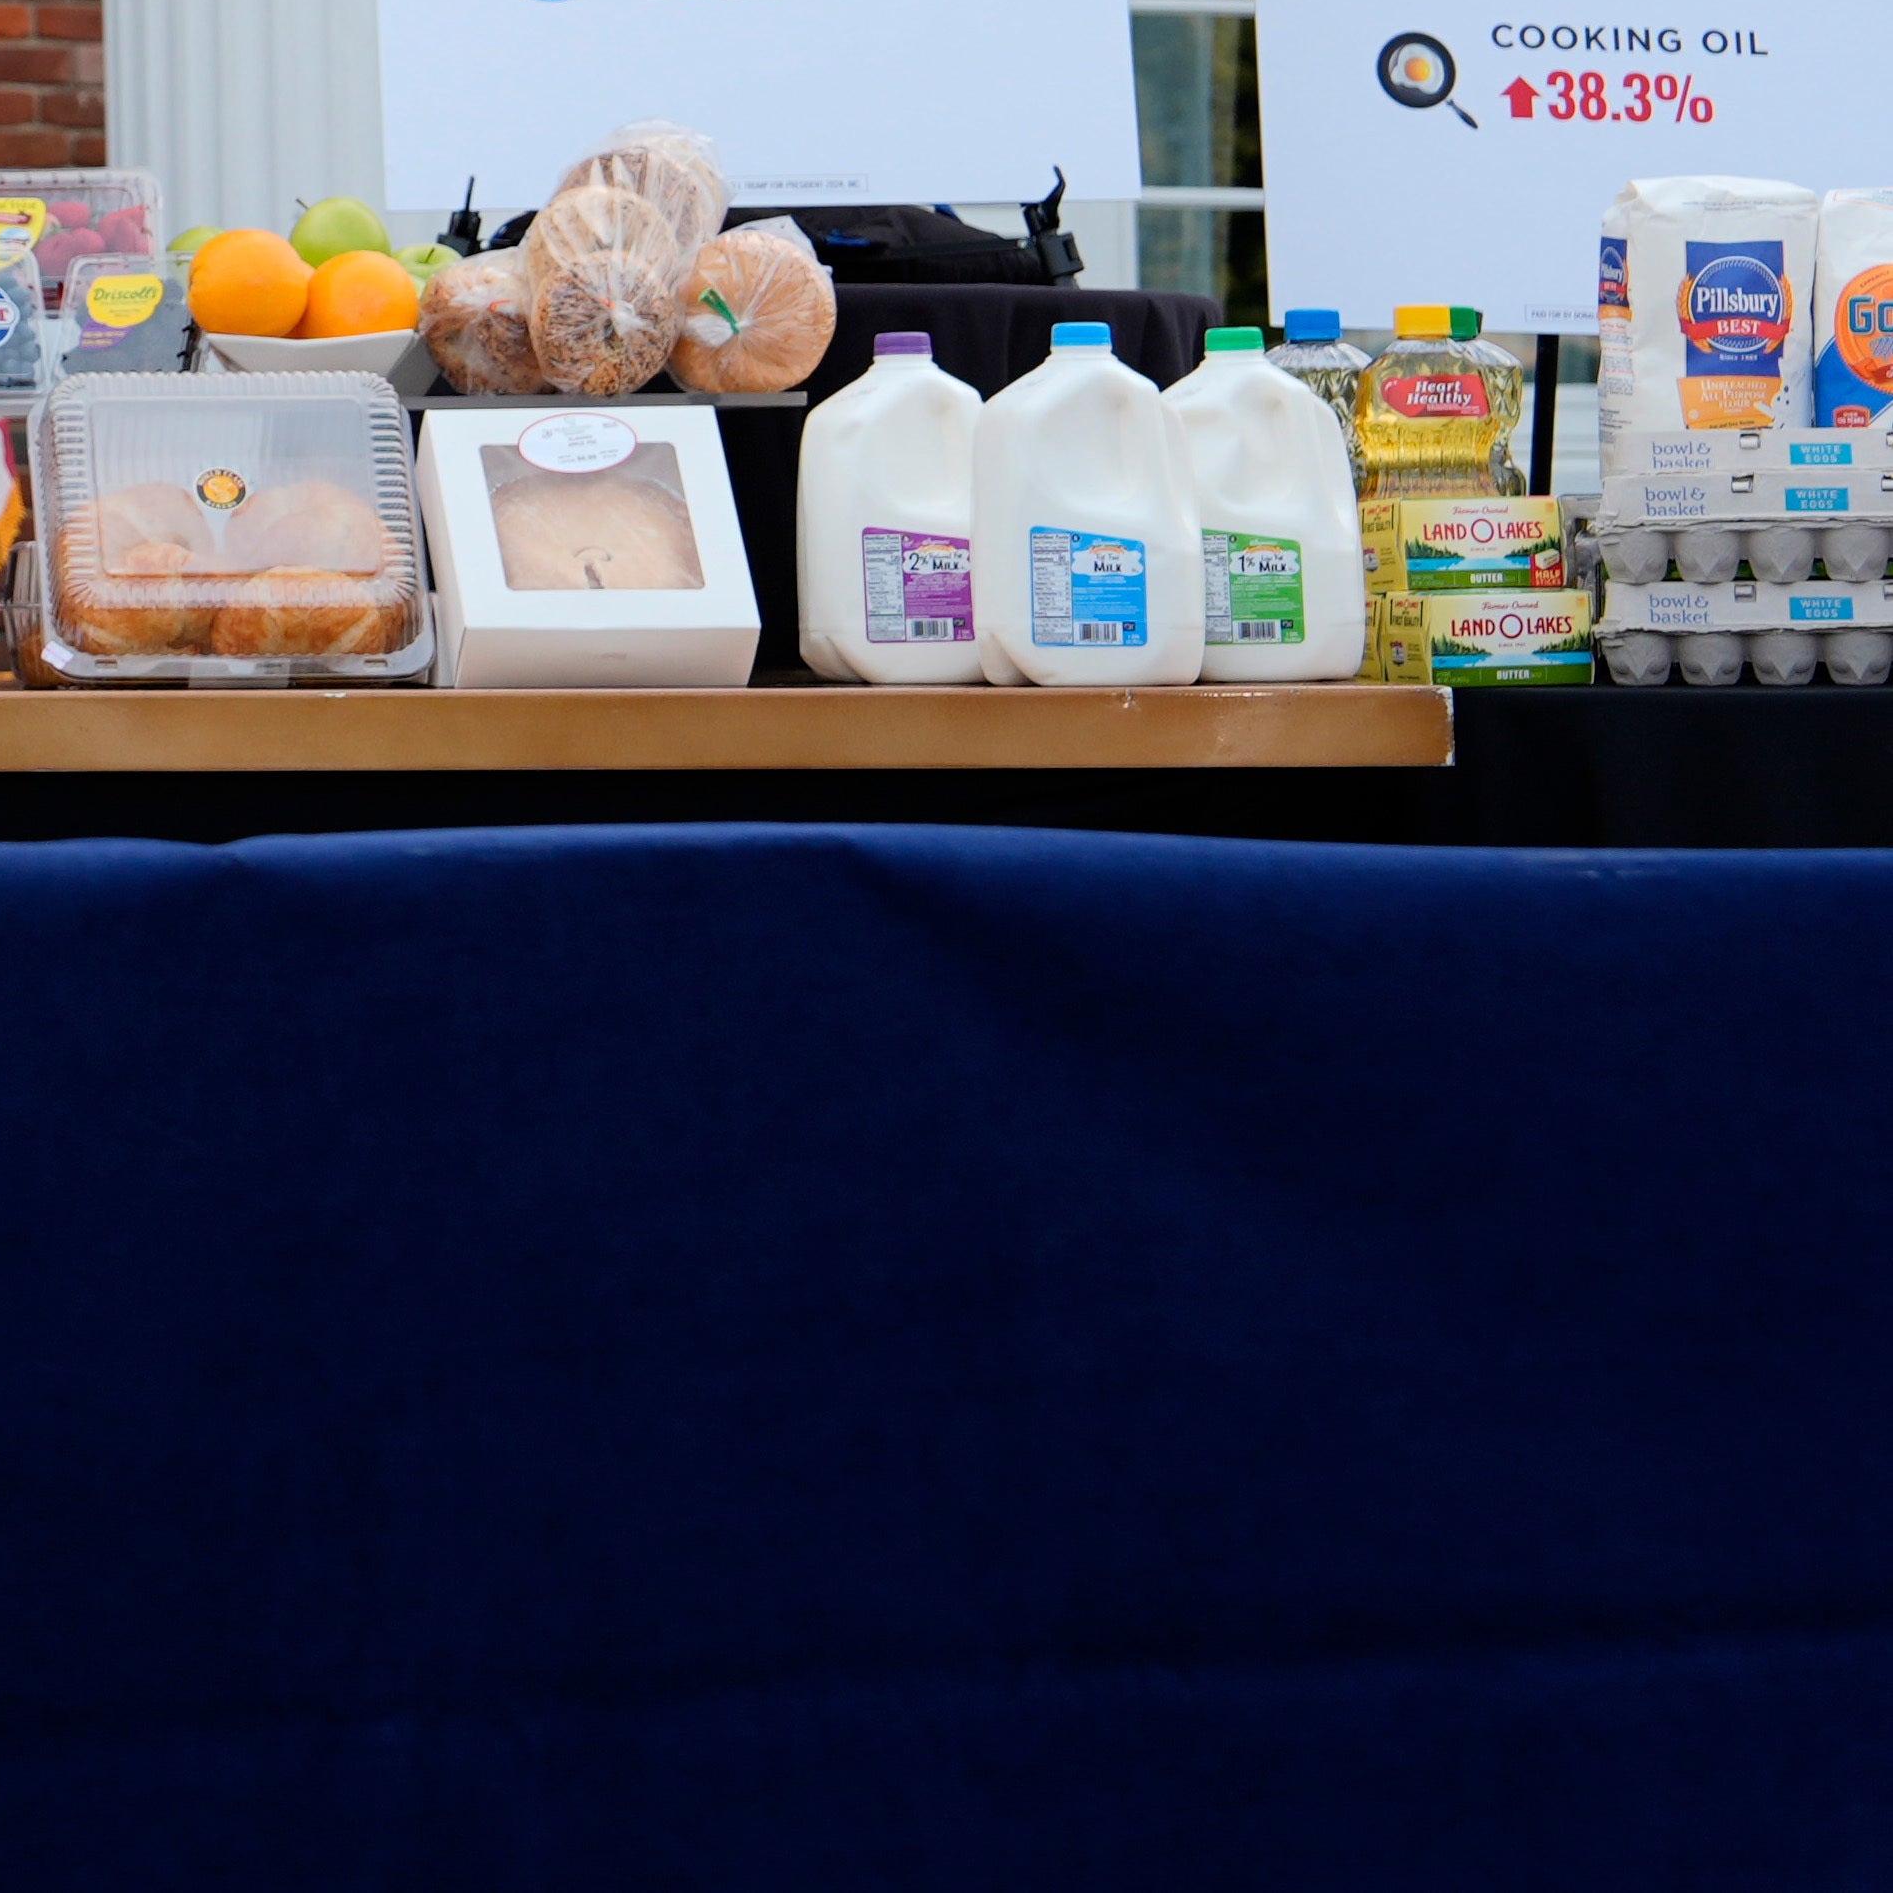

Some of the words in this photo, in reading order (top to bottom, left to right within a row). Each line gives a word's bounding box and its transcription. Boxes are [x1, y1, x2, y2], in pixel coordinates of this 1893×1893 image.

[1491, 24, 1682, 53] COOKING
[1701, 30, 1769, 55] OIL
[1546, 70, 1713, 124] 38.3%
[1696, 286, 1778, 317] Pillsbury
[1717, 320, 1760, 335] BEST
[1415, 380, 1461, 394] Heart
[1700, 378, 1767, 390] UNBLEACHED
[1407, 392, 1471, 406] Healthy
[1701, 390, 1720, 400] ALL
[1723, 390, 1767, 401] PURPOSE
[1719, 399, 1750, 409] FLOUR
[1652, 442, 1693, 455] bowl
[1697, 442, 1711, 455] &
[1799, 444, 1842, 454] WHITE
[1653, 456, 1711, 468] basket
[1804, 454, 1838, 463] EGGS
[1645, 486, 1686, 501] bowl
[1690, 487, 1706, 501] &
[1796, 490, 1838, 499] WHITE
[1646, 503, 1706, 517] basket
[1801, 500, 1833, 509] EGGS
[1423, 523, 1467, 541] LAND
[1470, 518, 1494, 543] O
[1497, 521, 1543, 539] LAKES
[909, 553, 929, 571] 2%
[933, 559, 959, 571] MILK
[1094, 561, 1122, 572] MILK
[1238, 555, 1255, 572] 1%
[1259, 561, 1286, 572] MILK
[1470, 572, 1503, 583] BUTTER
[1535, 569, 1560, 579] HALF
[1649, 594, 1691, 608] bowl
[1695, 595, 1709, 608] &
[1799, 600, 1842, 608] WHITE
[1650, 610, 1710, 624] basket
[1805, 609, 1838, 618] EGGS
[1451, 619, 1495, 637] LAND
[1499, 613, 1523, 639] O
[1527, 616, 1572, 634] LAKES
[1497, 669, 1530, 680] BUTTER
